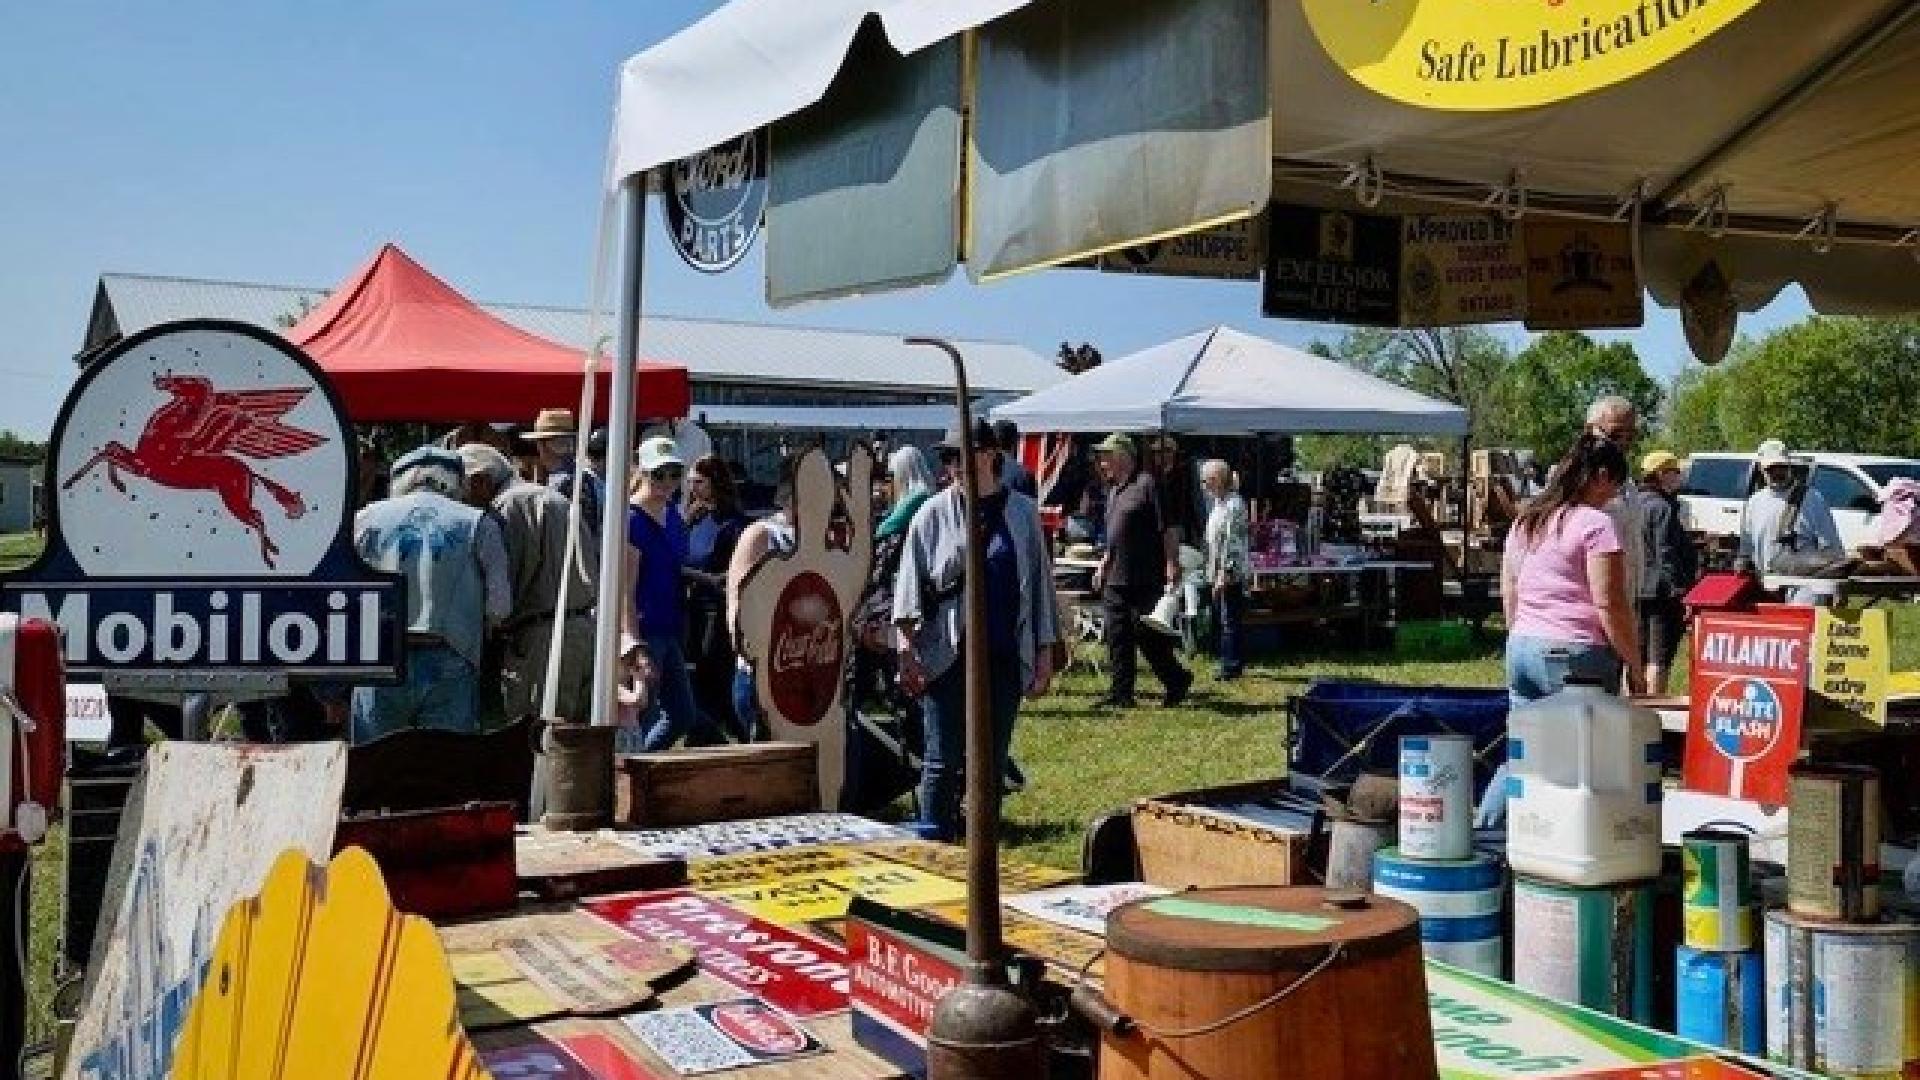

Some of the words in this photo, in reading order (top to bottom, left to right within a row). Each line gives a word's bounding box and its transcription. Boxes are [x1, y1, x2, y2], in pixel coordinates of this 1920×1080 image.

[1417, 39, 1486, 82] Safe
[1495, 0, 1707, 79] Lubricatio
[681, 212, 746, 263] PARTS
[1407, 219, 1488, 244] APPROVED
[1276, 257, 1391, 291] EXCELSIOR
[1309, 284, 1360, 313] LIFE
[20, 591, 381, 664] Mobiloil
[1701, 632, 1801, 671] ATLANTIC
[1826, 641, 1870, 659] home
[1714, 696, 1774, 720] WHITE
[1714, 716, 1772, 740] FLASH
[902, 953, 960, 1000] Good
